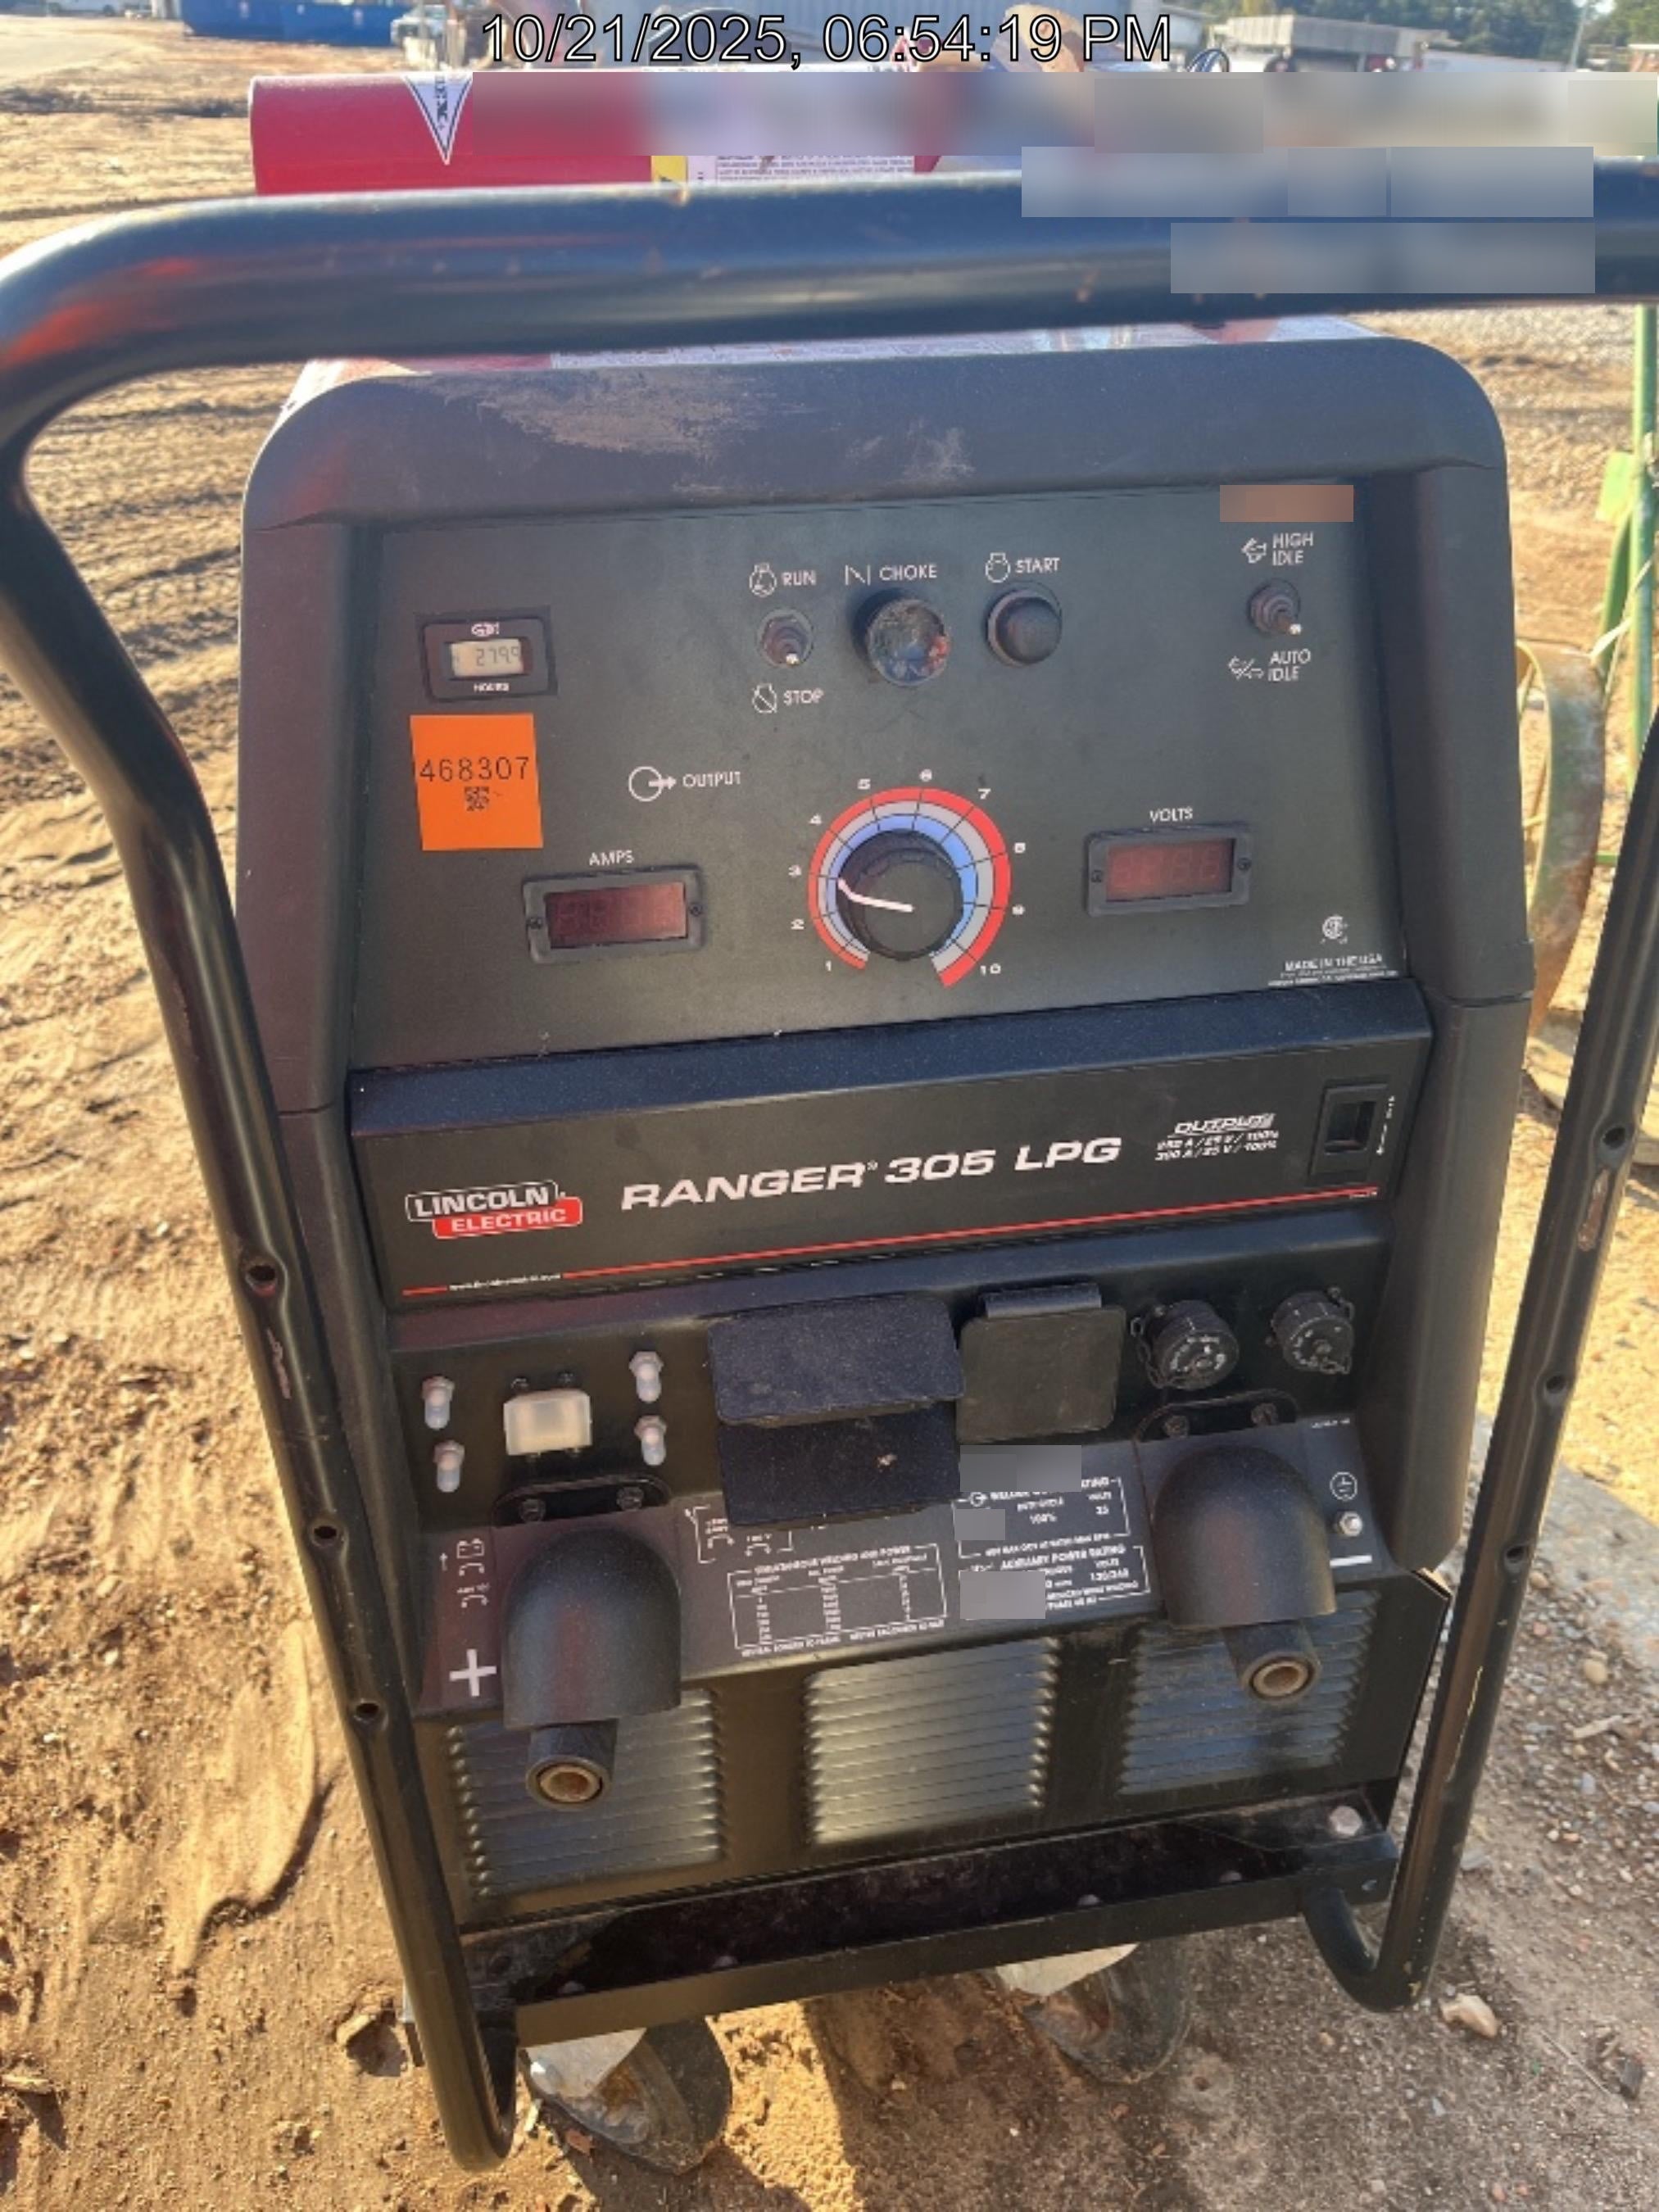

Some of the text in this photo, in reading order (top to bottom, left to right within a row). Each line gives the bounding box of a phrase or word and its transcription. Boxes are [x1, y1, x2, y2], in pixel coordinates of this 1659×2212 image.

[1272, 531, 1313, 549] HIGH
[1015, 557, 1060, 573] START
[1272, 550, 1303, 565] IDLE
[783, 569, 816, 586] RUN
[879, 564, 937, 582] CHOKE
[1271, 648, 1311, 664] AUTO
[1268, 666, 1299, 682] IDLE
[783, 689, 823, 705] STOP
[419, 756, 529, 782] 468307
[919, 768, 932, 782] 6
[682, 771, 741, 787] OUTPUT
[857, 778, 871, 790] 5
[978, 788, 991, 800] 7
[809, 814, 822, 825] 4
[1149, 806, 1193, 823] VOLTS
[589, 850, 634, 866] AMPS
[788, 864, 802, 877] 3
[791, 918, 805, 930] 2
[825, 961, 832, 972] 1
[979, 963, 1001, 977] 10
[885, 1149, 995, 1185] 305
[1015, 1137, 1122, 1172] LPG
[415, 1186, 550, 1217] LINCOLN
[451, 1208, 567, 1232] ELECTRIC
